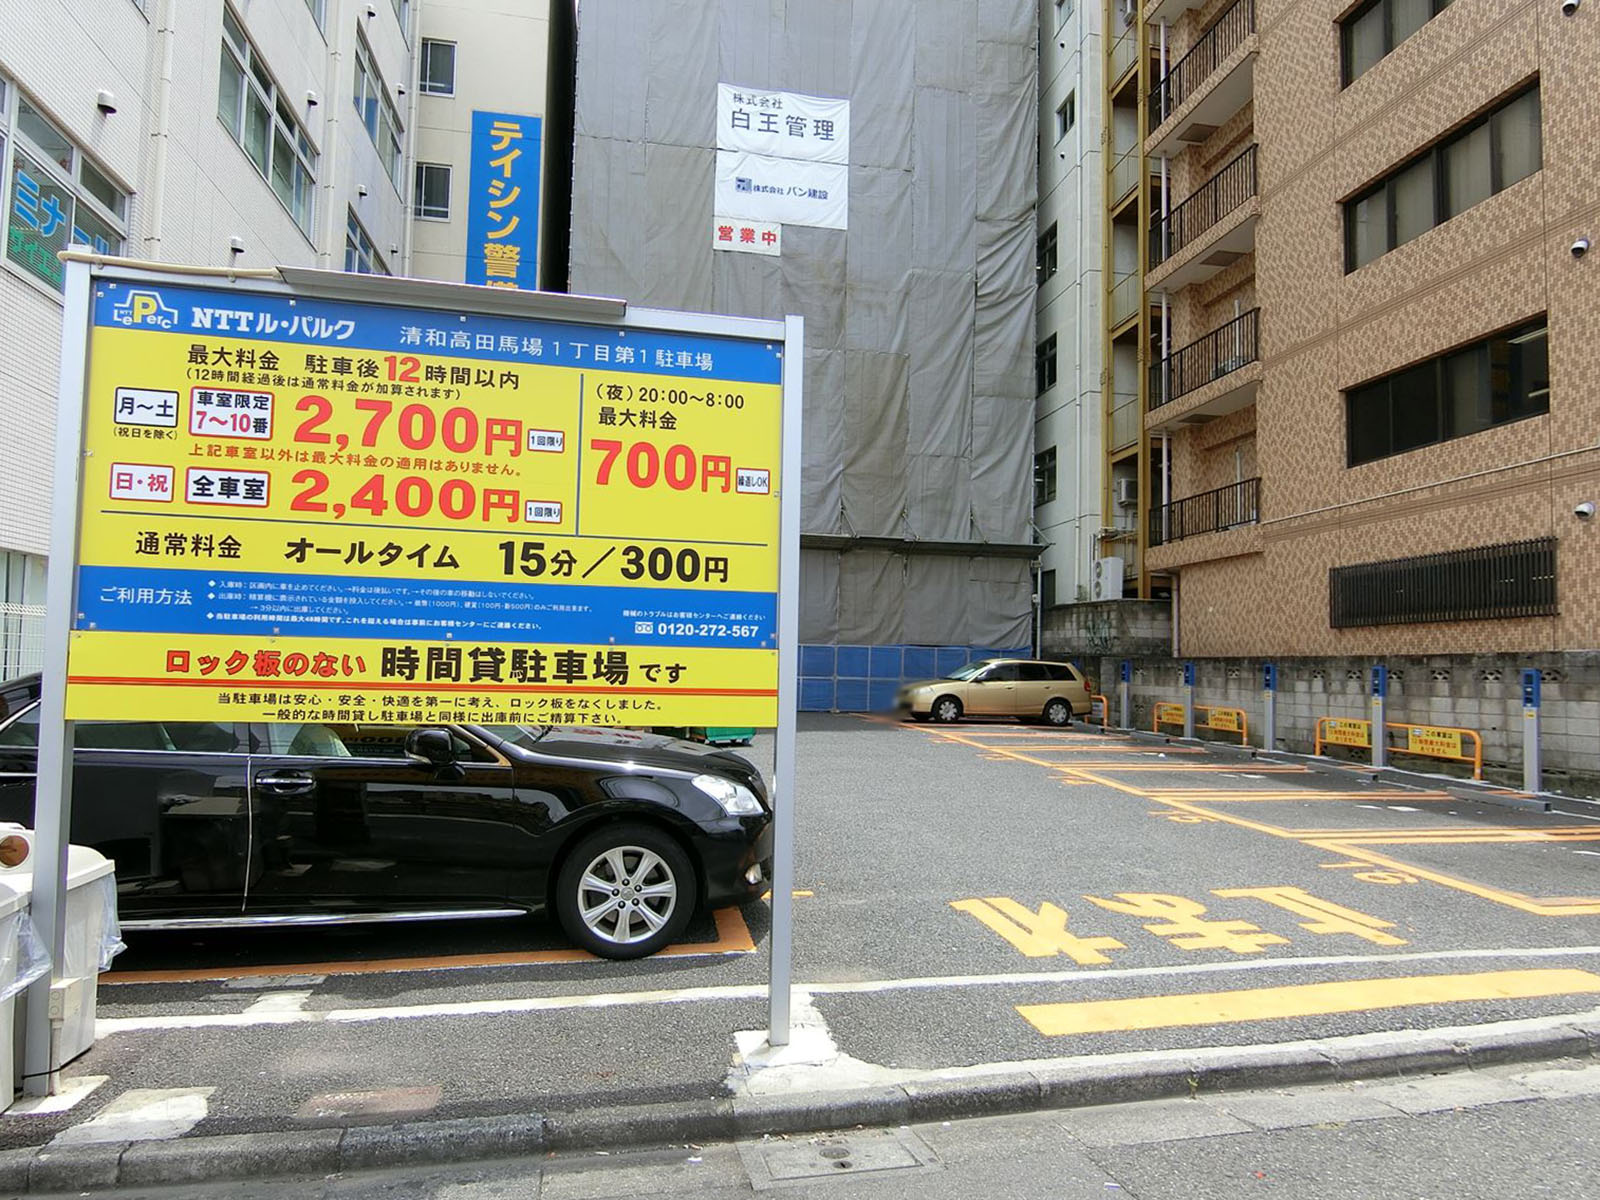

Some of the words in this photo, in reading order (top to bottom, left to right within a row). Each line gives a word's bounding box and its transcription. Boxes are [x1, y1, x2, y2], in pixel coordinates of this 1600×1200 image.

[733, 93, 783, 109] 株式会社
[731, 108, 834, 141] 白王管理
[484, 121, 522, 288] テイシン警
[718, 226, 776, 246] 営業中
[187, 344, 280, 370] 最大料金
[304, 353, 520, 390] 駐車後12時間以内
[196, 391, 270, 411] 車室限定
[293, 395, 523, 457] 2,700円
[598, 406, 678, 430] 最大料金
[188, 443, 521, 477] 上記車室以外は最大料金の適用はありません。
[590, 438, 732, 494] 700円
[191, 475, 266, 502] 全車室
[289, 469, 520, 523] 2,400円
[135, 531, 242, 559] 通常料金
[284, 538, 460, 569] オールタイム
[100, 586, 192, 606] ご利用方法
[658, 623, 759, 638] 0120-272-567
[166, 649, 367, 677] ロック板のない
[948, 886, 1410, 965] 止まれ
